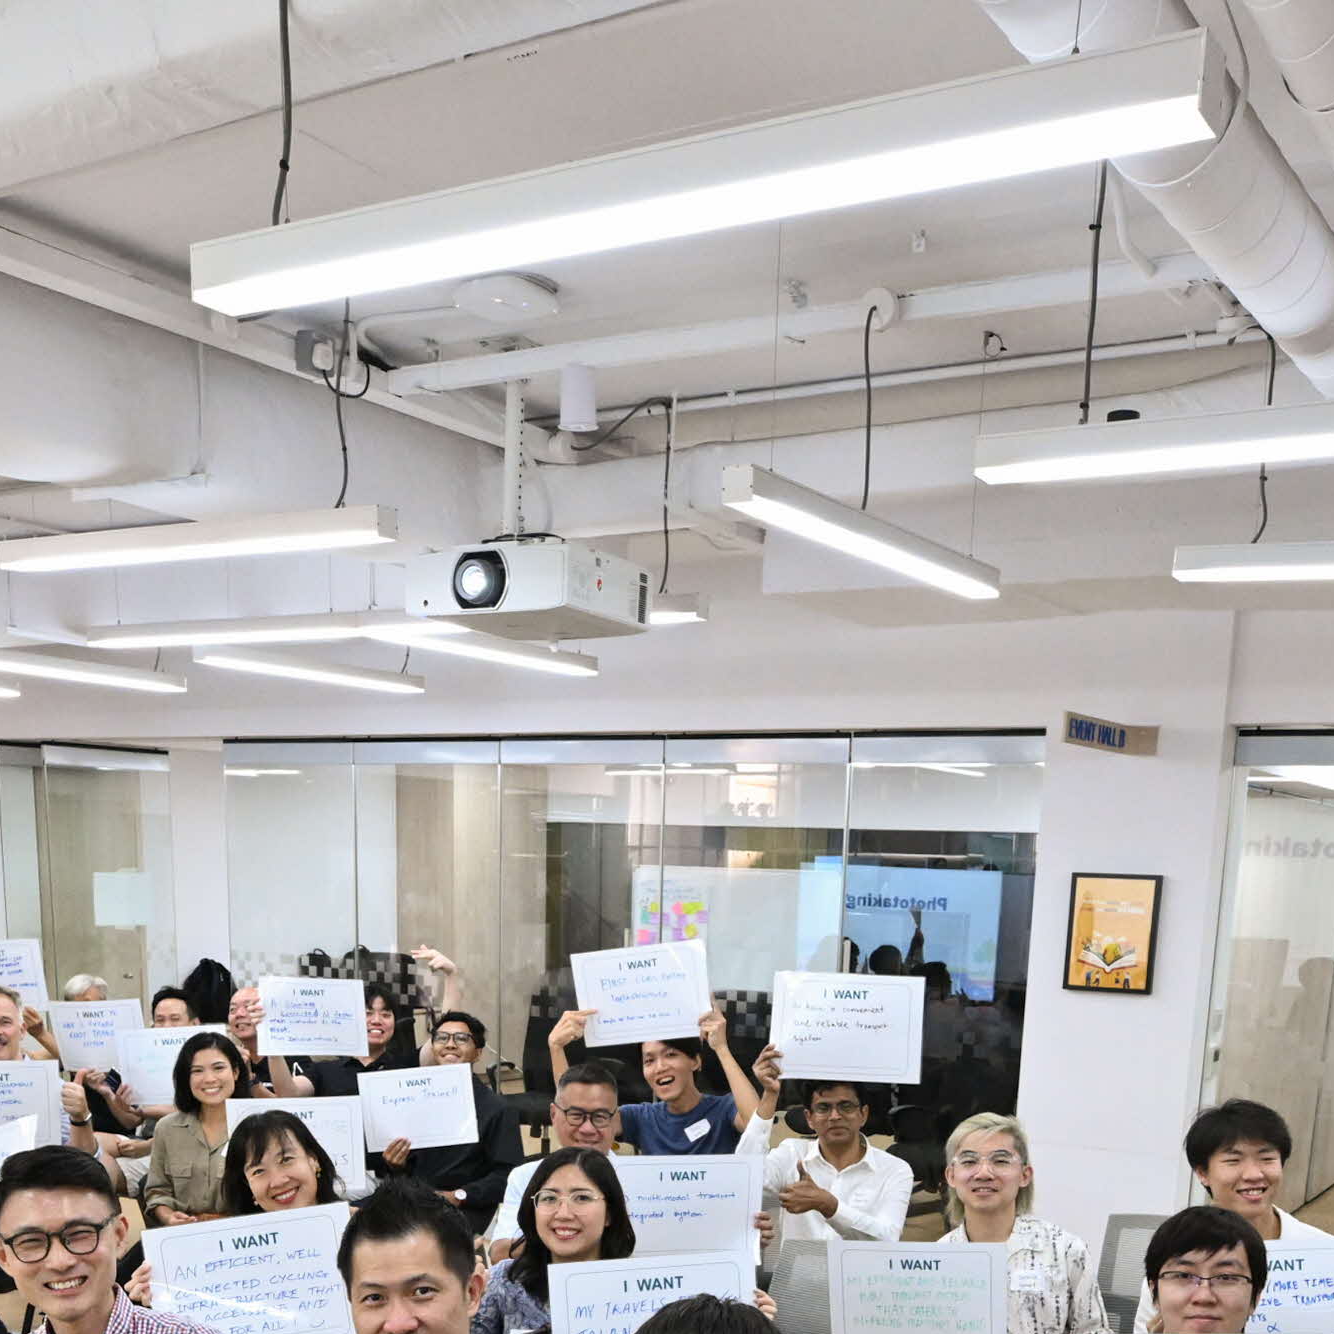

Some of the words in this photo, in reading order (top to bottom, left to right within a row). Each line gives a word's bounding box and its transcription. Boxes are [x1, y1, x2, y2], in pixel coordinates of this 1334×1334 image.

[627, 959, 657, 970] WANT
[834, 990, 869, 999] WANT
[856, 1023, 888, 1032] transport
[161, 1037, 188, 1046] WANT
[793, 1035, 822, 1046] system
[399, 1080, 402, 1088] I
[405, 1078, 432, 1088] WANT
[660, 1172, 663, 1181] I
[670, 1171, 707, 1181] WANT
[697, 1192, 736, 1200] transport
[219, 1240, 224, 1252] I
[232, 1232, 279, 1250] WANT
[174, 1265, 197, 1281] AN
[205, 1253, 281, 1273] EFFICIENT,
[286, 1248, 321, 1259] WELL
[889, 1260, 892, 1269] I
[901, 1260, 941, 1271] WANT
[308, 1283, 341, 1296] THAT
[623, 1280, 627, 1293] I
[637, 1276, 684, 1292] WANT
[575, 1304, 594, 1320] MY
[605, 1301, 665, 1320] TRAVELS
[262, 1320, 284, 1332] ALL
